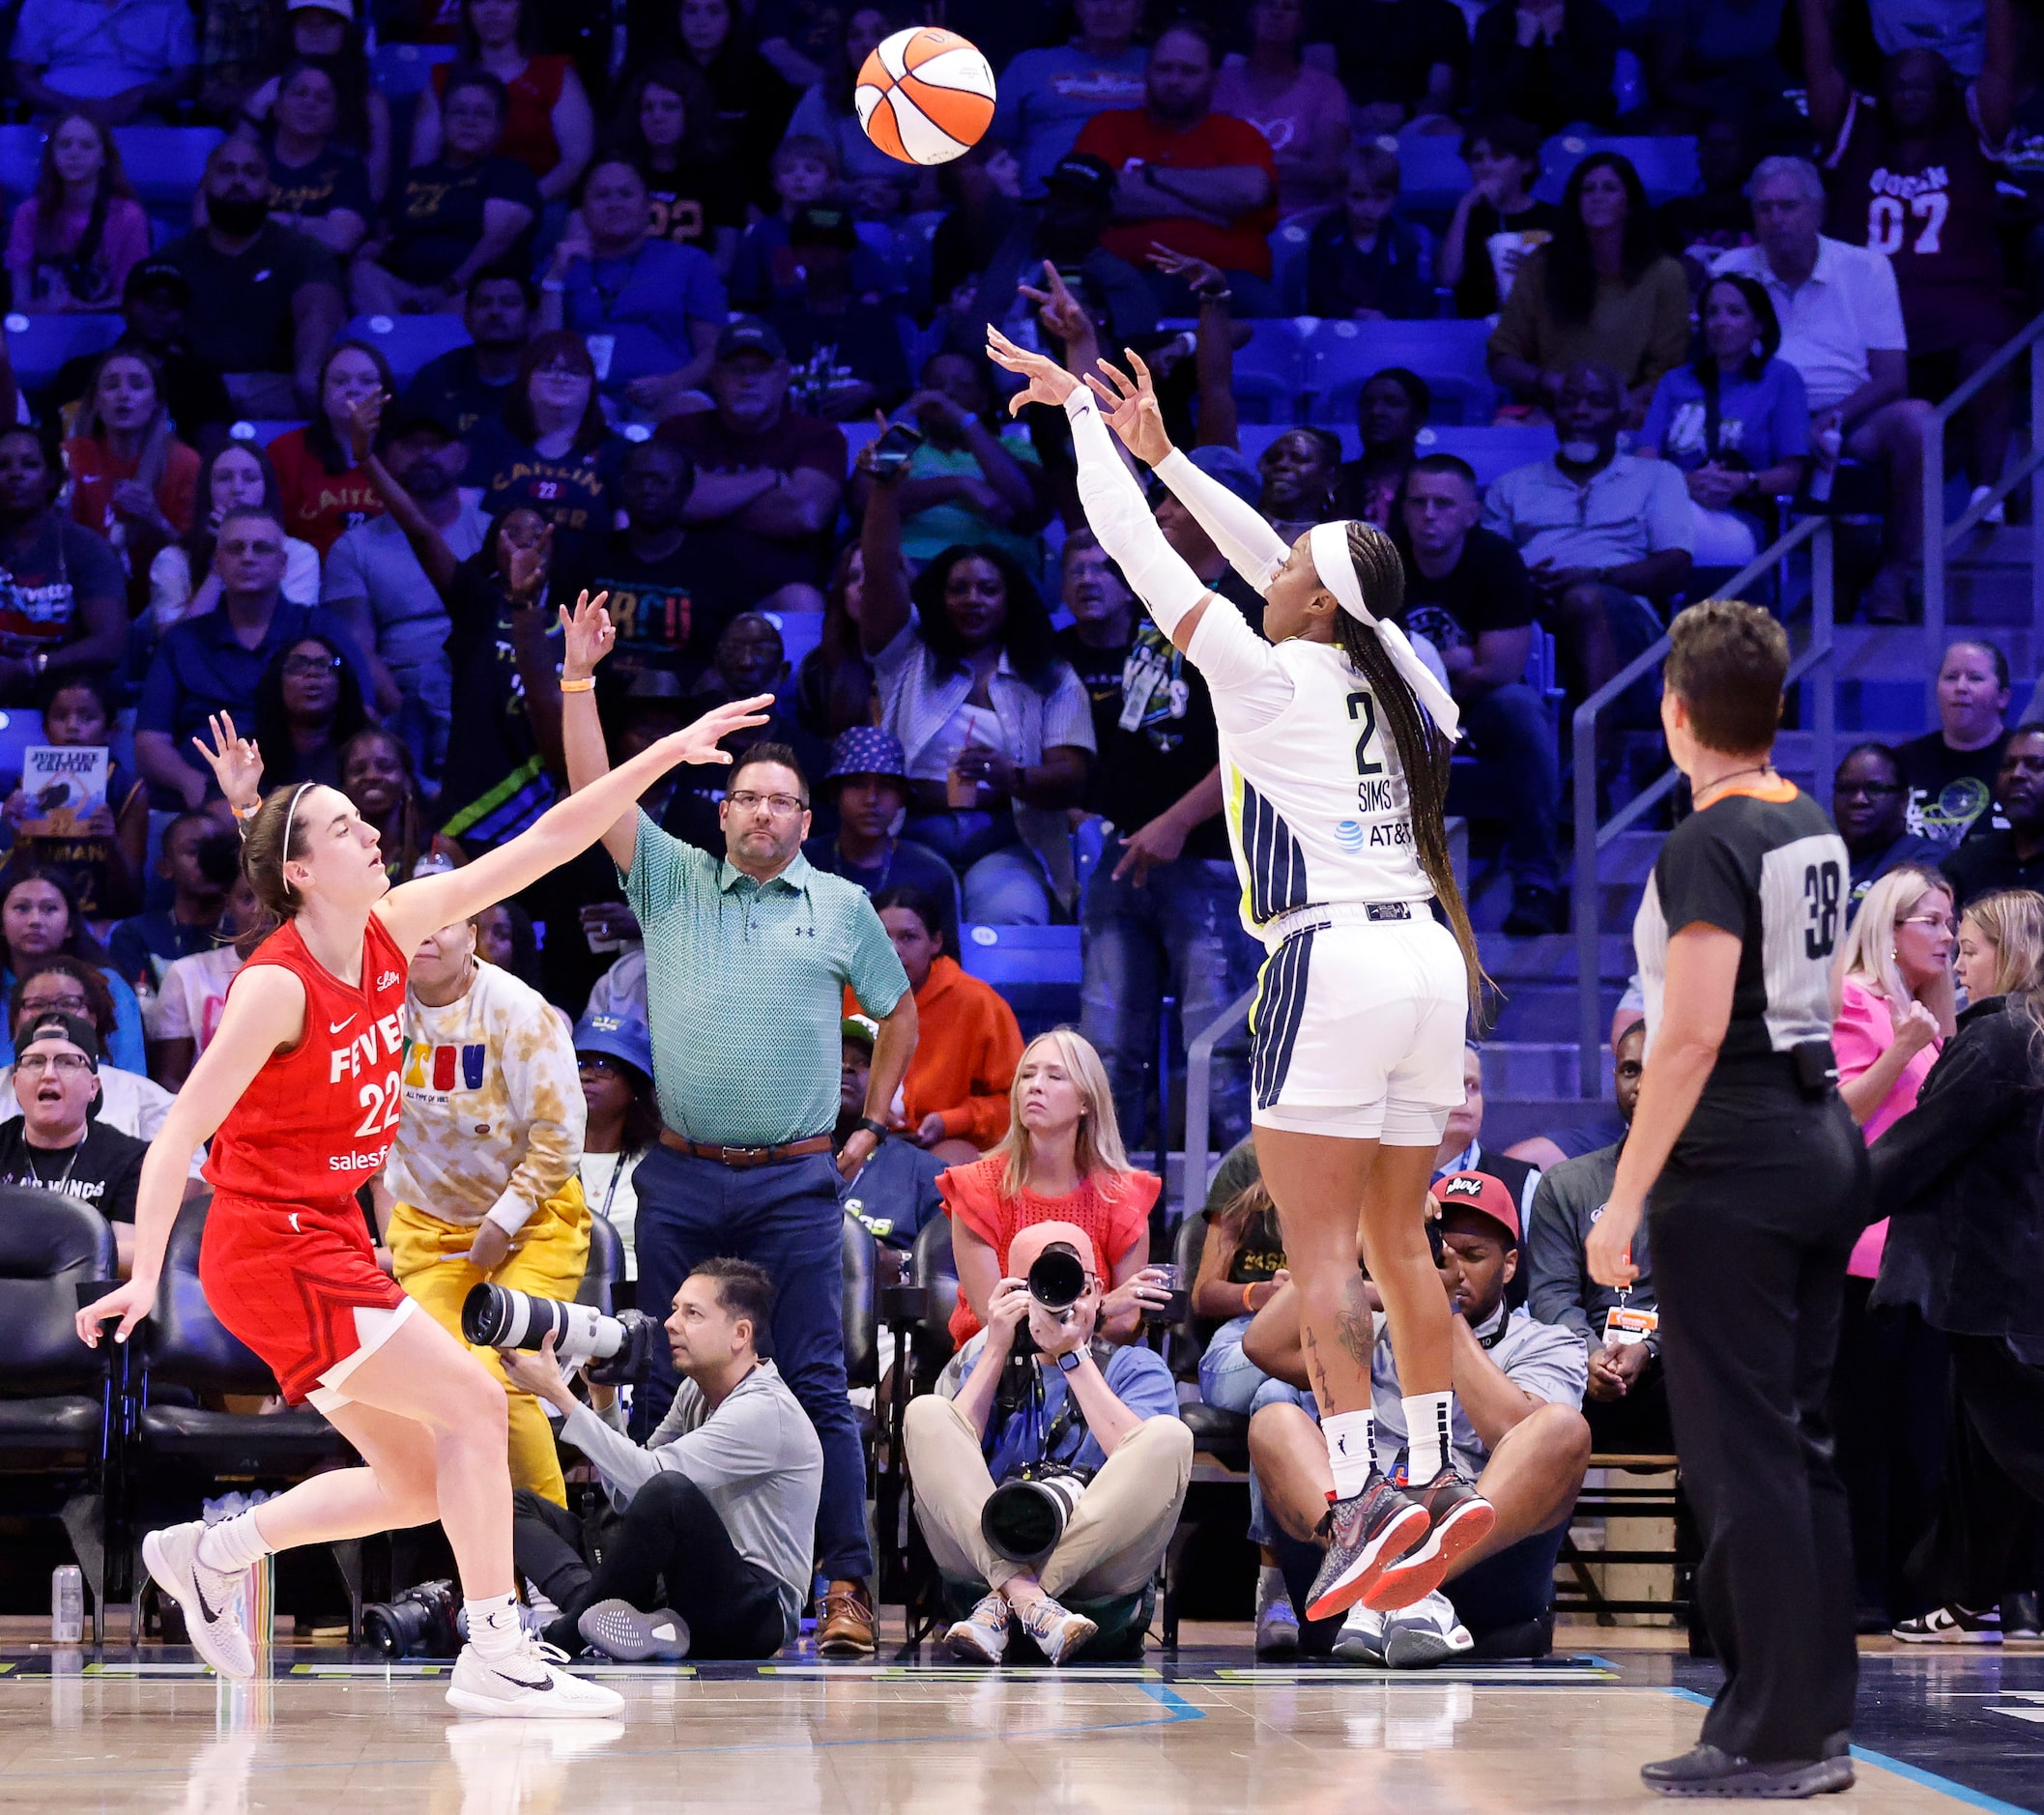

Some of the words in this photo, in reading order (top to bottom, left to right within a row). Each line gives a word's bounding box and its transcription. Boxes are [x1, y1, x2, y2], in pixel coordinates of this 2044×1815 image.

[1867, 191, 1950, 255] 07
[1345, 690, 1383, 775] 2
[1358, 779, 1392, 813] SIMS
[1369, 823, 1412, 848] AT&T
[1804, 859, 1840, 961] 38
[376, 969, 400, 993] Lilly
[354, 1070, 401, 1138] 22
